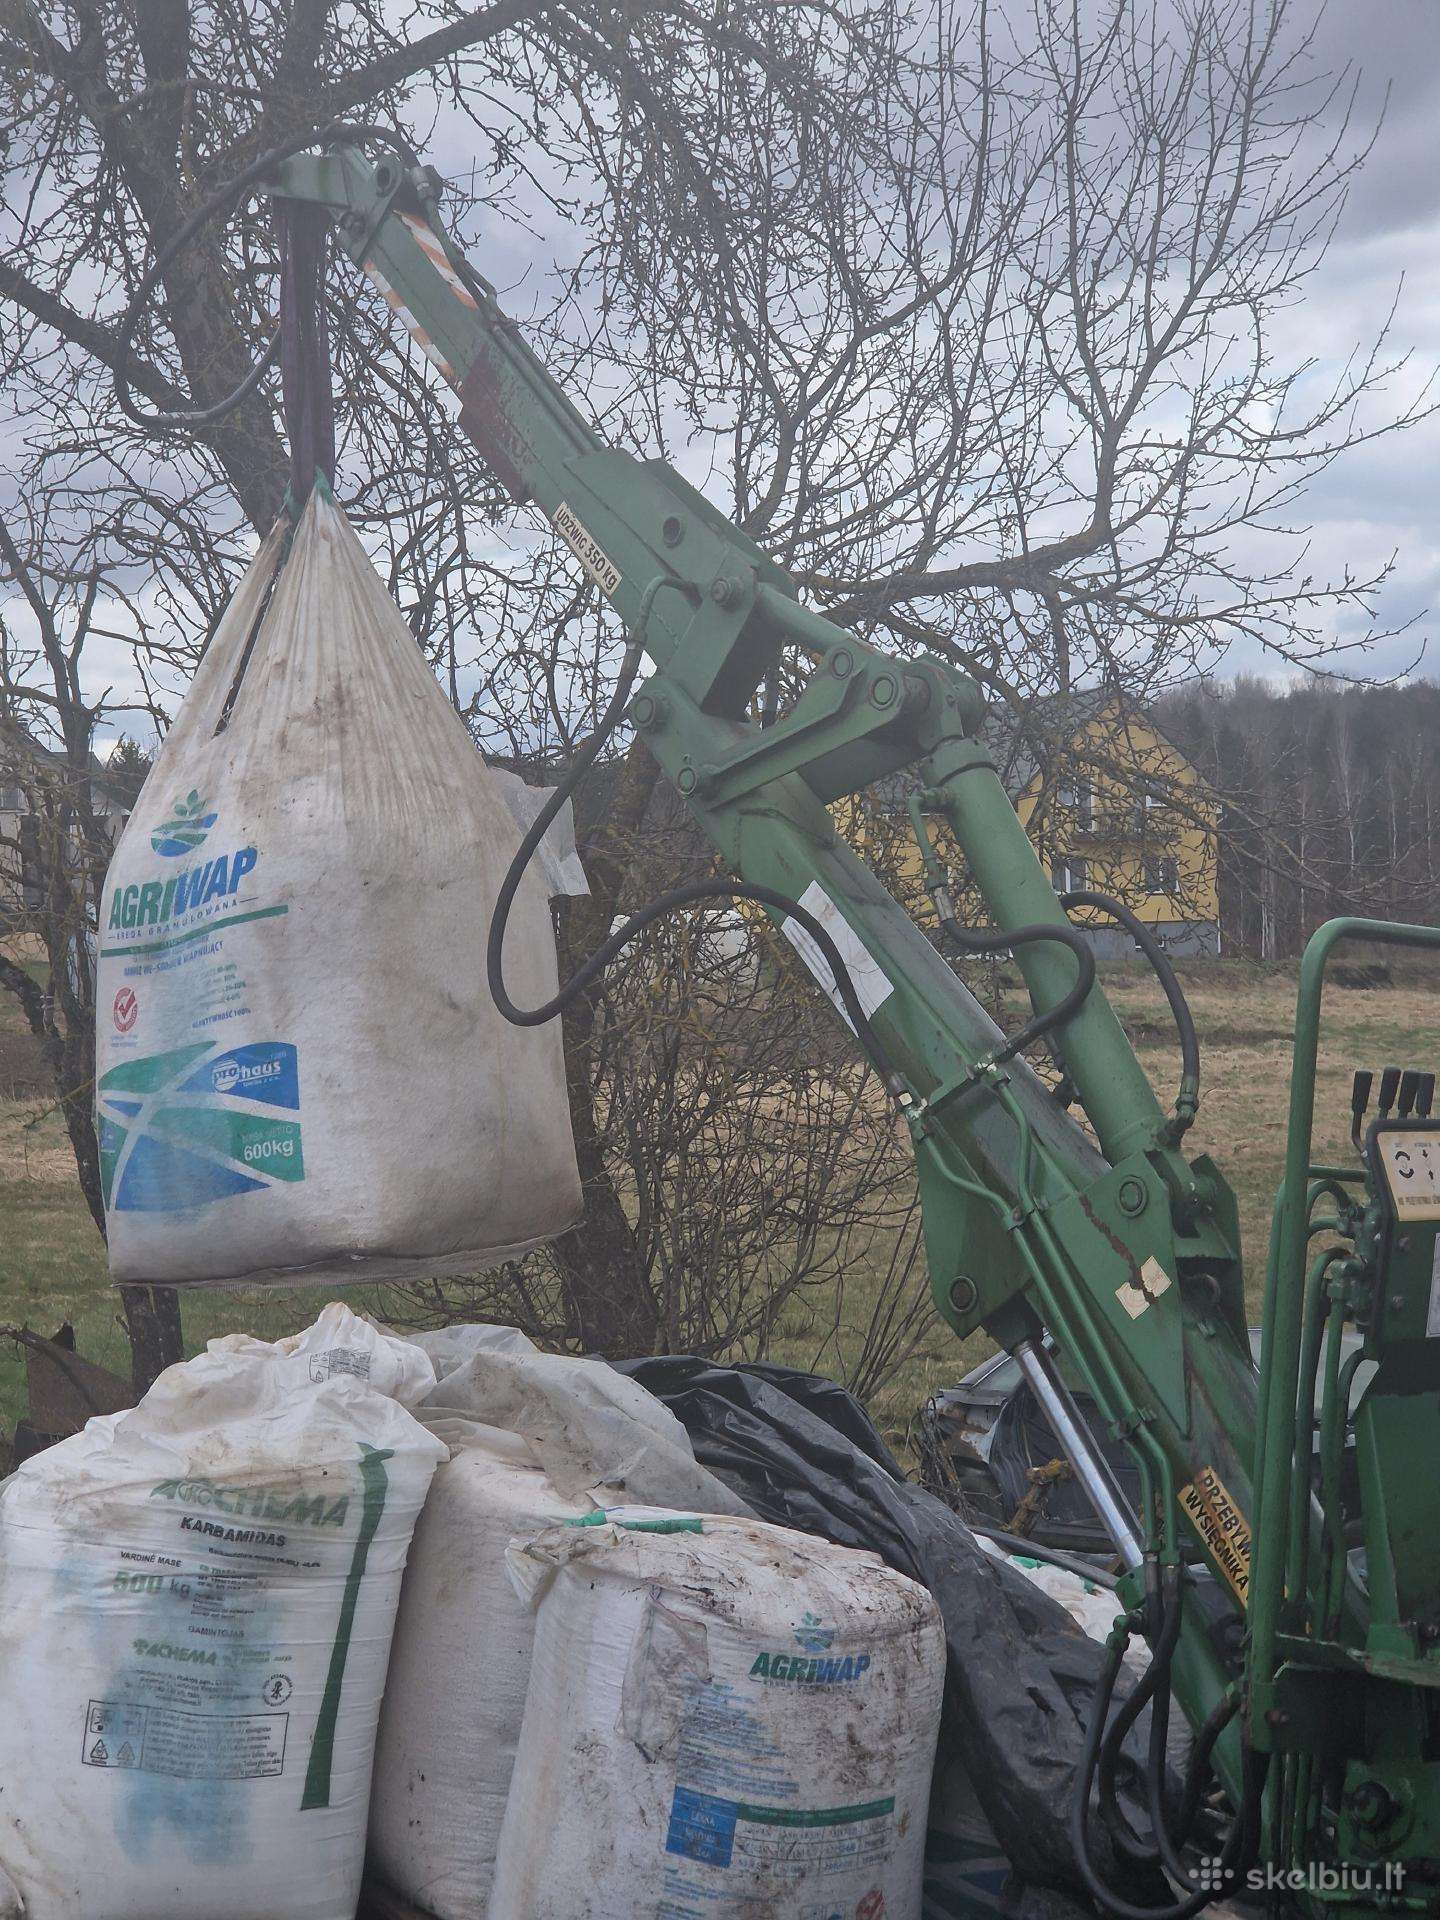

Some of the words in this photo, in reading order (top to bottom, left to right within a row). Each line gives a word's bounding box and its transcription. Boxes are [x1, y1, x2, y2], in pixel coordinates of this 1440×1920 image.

[584, 543, 606, 572] 350
[602, 565, 618, 591] kg
[108, 847, 258, 930] AGRIWAP
[148, 899, 238, 936] GRANULOWANA
[244, 1139, 294, 1161] 600kg
[180, 1516, 287, 1548] KARBAMIDAS
[1203, 1474, 1251, 1562] PRZEBYW
[120, 1551, 156, 1563] VARDINĖ
[169, 1577, 191, 1598] kg
[748, 1652, 871, 1683] AGRIWAP
